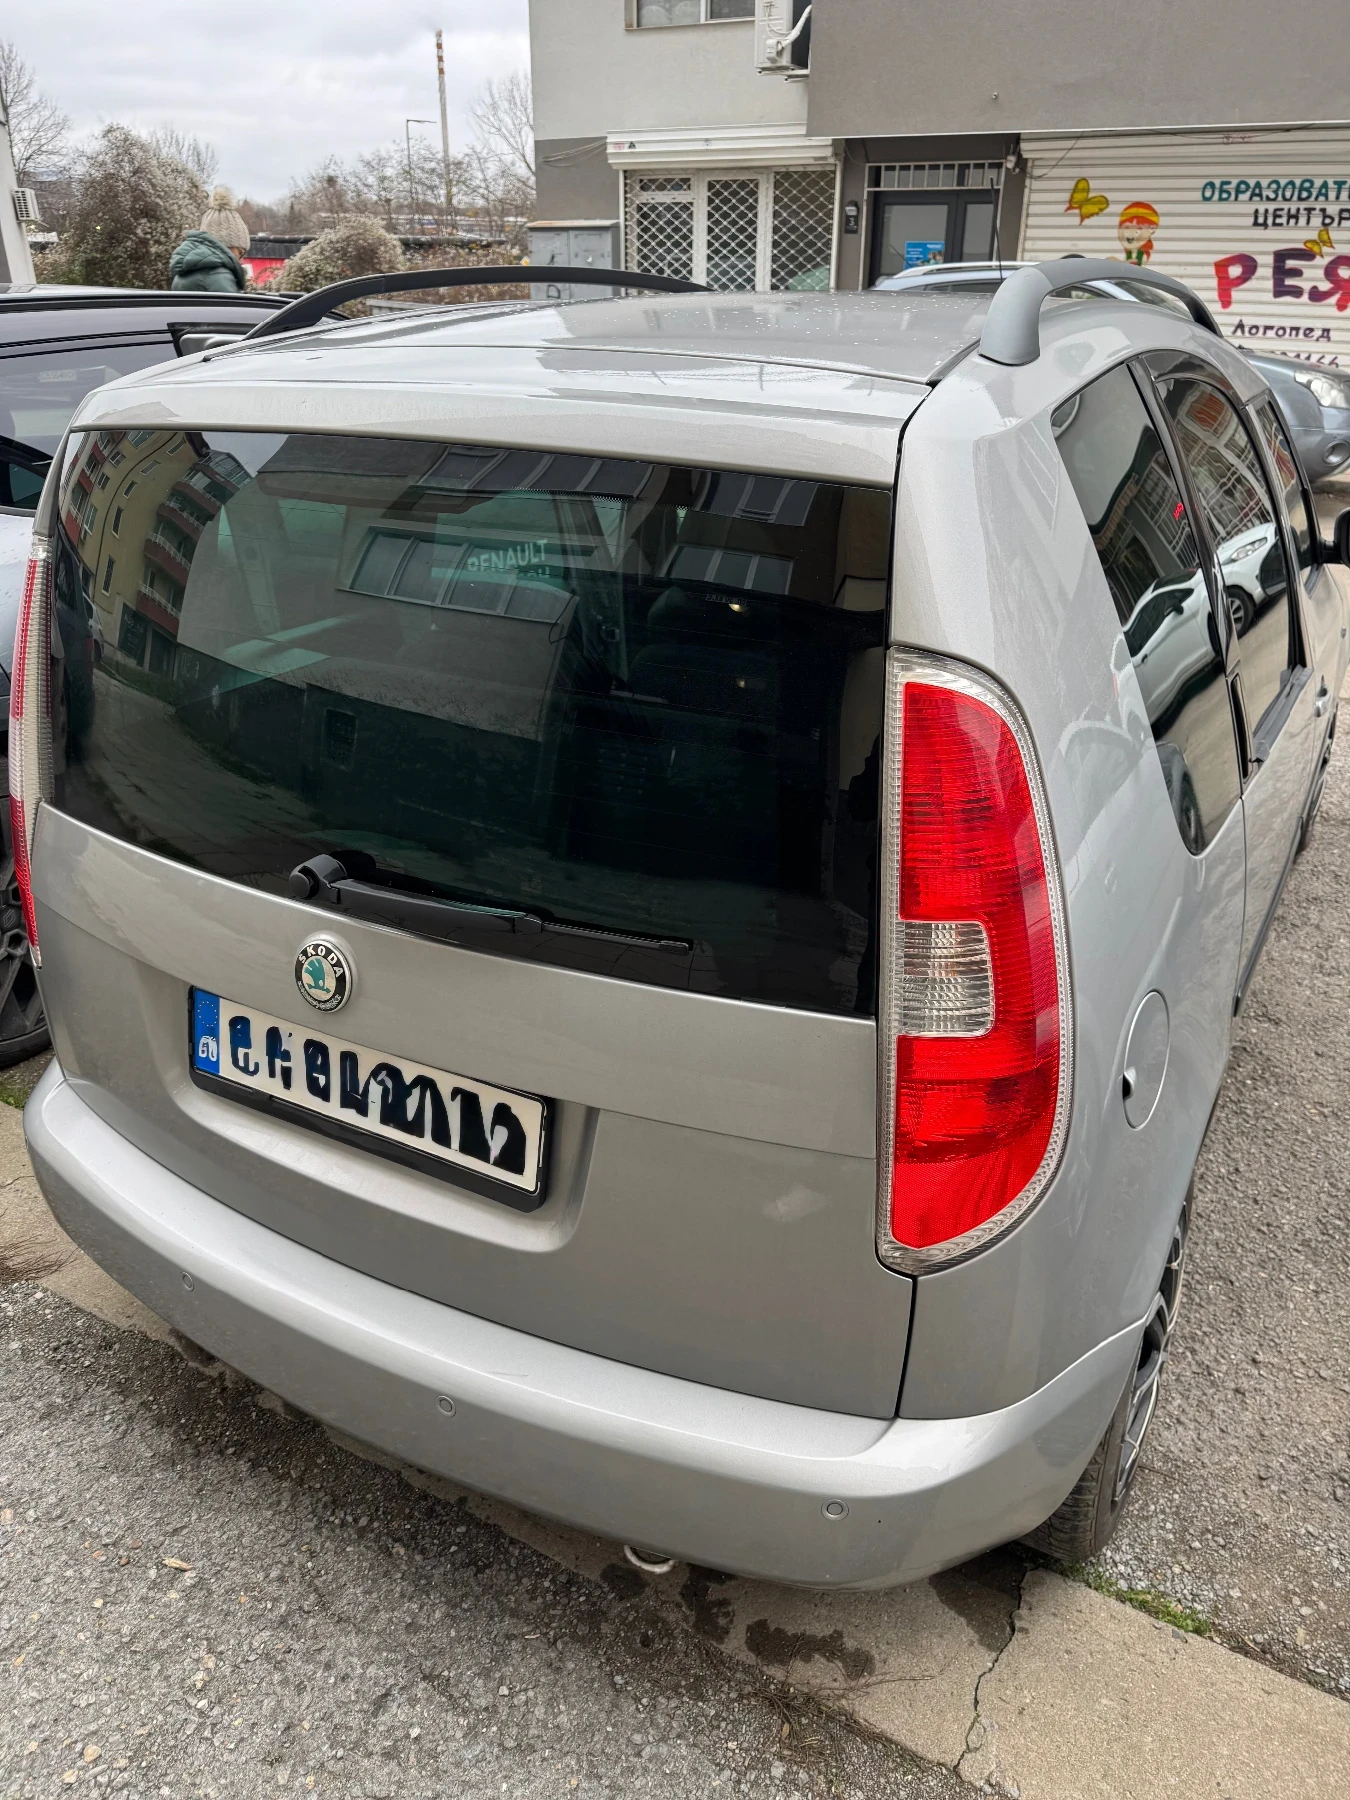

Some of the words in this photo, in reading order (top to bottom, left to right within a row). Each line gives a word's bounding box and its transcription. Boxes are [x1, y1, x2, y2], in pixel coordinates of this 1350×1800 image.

[1201, 178, 1350, 202] ОБРАЗОВАТ
[1252, 206, 1350, 230] ЦЕНТЪР
[1213, 247, 1350, 312] РЕЯ
[1231, 319, 1332, 342] Логопед
